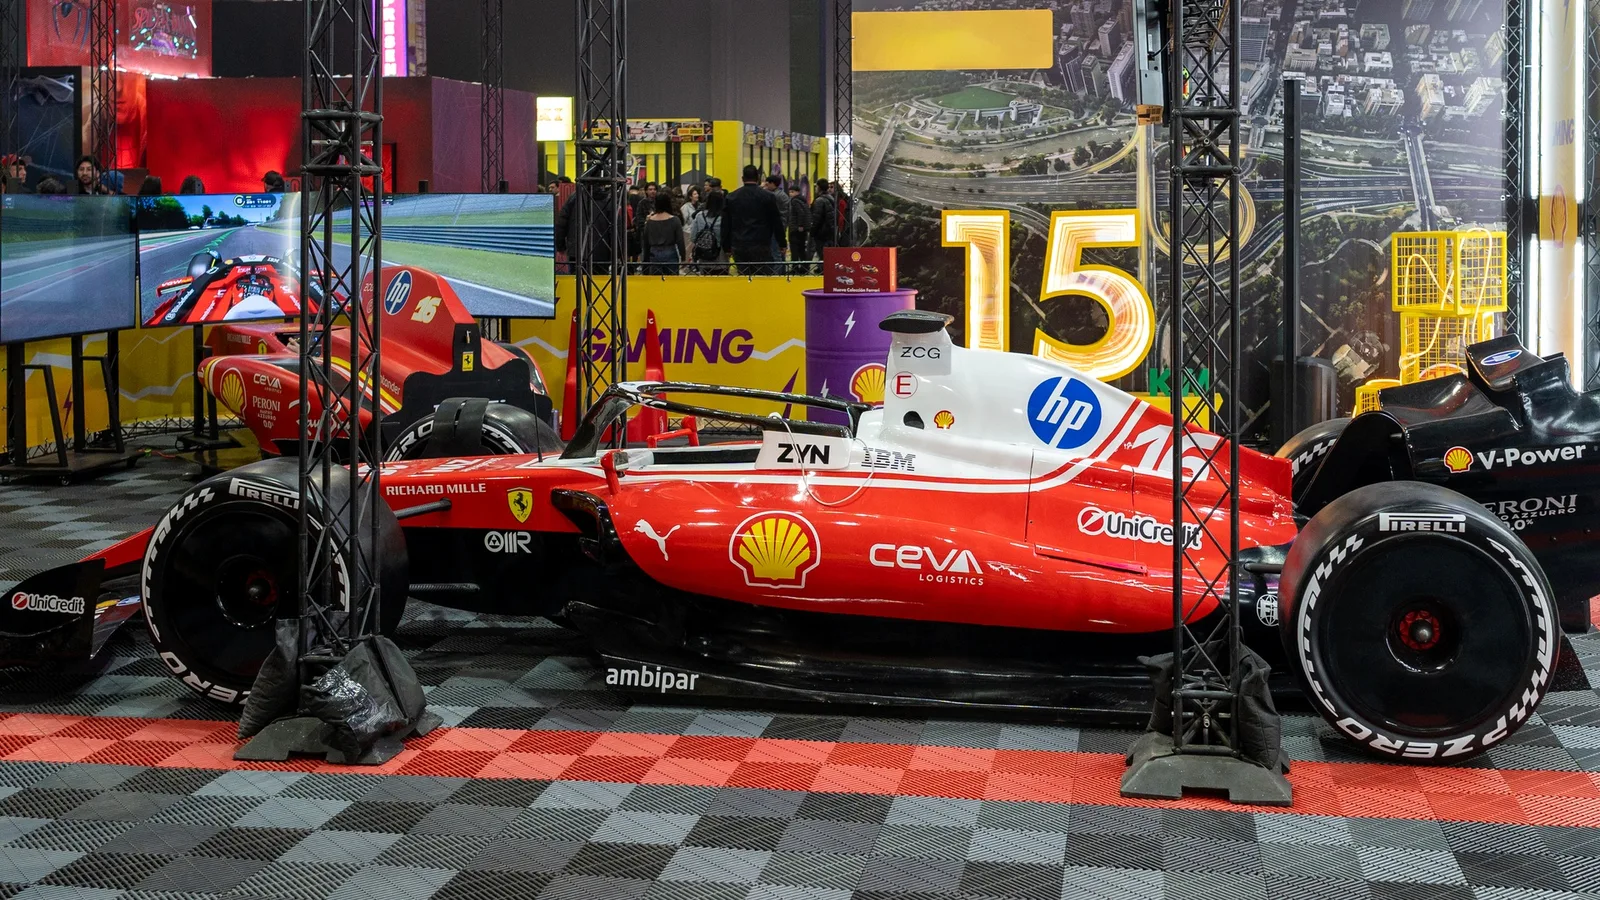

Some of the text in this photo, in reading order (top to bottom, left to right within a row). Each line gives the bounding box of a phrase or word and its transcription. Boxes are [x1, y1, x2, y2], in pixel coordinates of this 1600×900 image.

[941, 208, 1155, 381] 15
[411, 296, 442, 324] 16
[900, 346, 940, 360] ZCG
[252, 396, 280, 412] PERONI
[1036, 376, 1094, 449] hp
[776, 443, 830, 465] ZYN
[861, 446, 916, 472] IBM
[1477, 444, 1587, 470] V-Power
[229, 477, 299, 510] PIRELLI
[386, 483, 486, 496] RICHARD MILLE
[1482, 494, 1578, 516] ERONI
[1511, 507, 1577, 520] AZZURRO
[1378, 512, 1467, 533] PIRELLI
[919, 573, 984, 586] LOGISTICS
[28, 593, 85, 614] UniCredit
[606, 666, 699, 693] ambipar
[1336, 717, 1476, 759] ZERO
